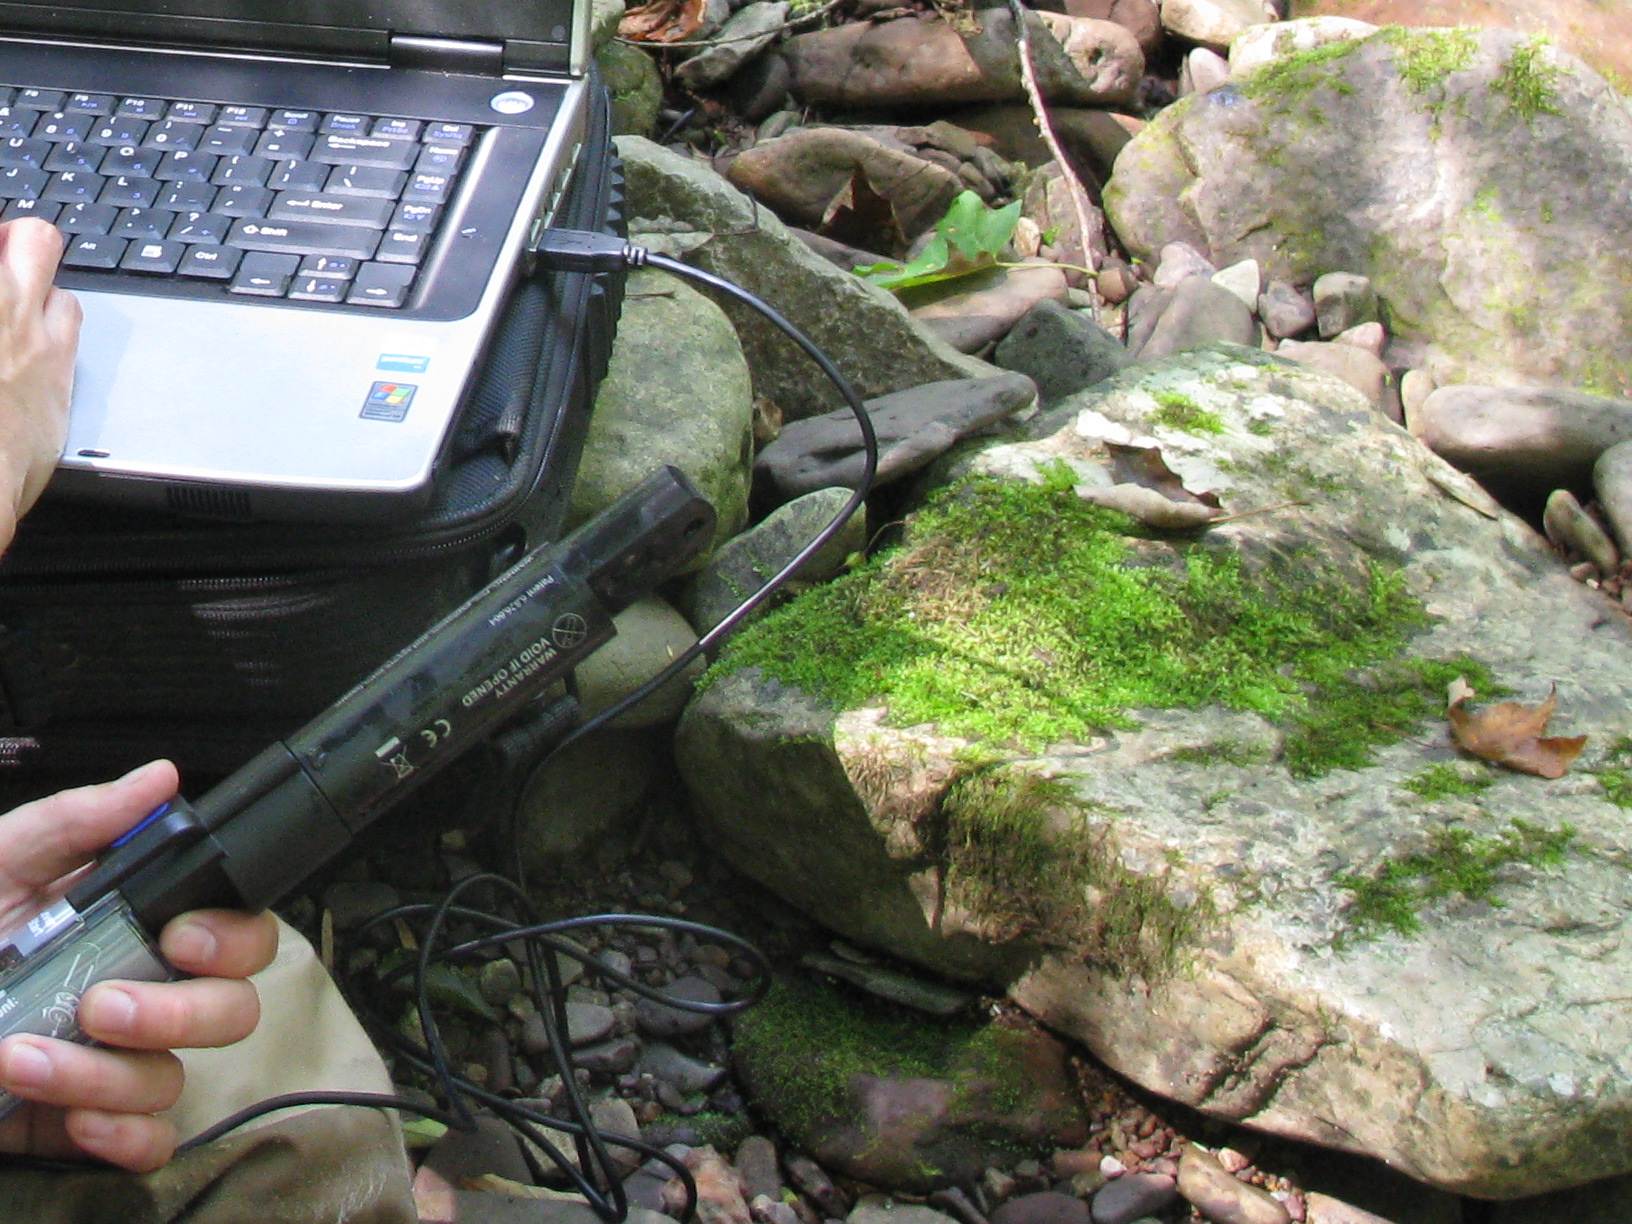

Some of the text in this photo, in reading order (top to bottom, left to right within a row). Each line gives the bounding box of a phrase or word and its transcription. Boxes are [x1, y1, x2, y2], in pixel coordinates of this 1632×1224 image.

[125, 99, 145, 107] F10
[333, 115, 361, 124] Pause
[101, 129, 112, 137] 9
[156, 133, 167, 143] 0
[9, 138, 23, 147] U
[328, 135, 391, 147] Backspace
[120, 147, 135, 156] O
[174, 151, 189, 160] P
[429, 147, 459, 156] Home
[6, 168, 18, 177] J
[62, 172, 75, 182] K
[118, 177, 128, 186] L
[417, 176, 445, 185] PgUp
[18, 199, 35, 209] M
[311, 200, 344, 210] Enter
[404, 205, 432, 215] PgDn
[189, 212, 200, 223] ?
[260, 227, 288, 237] Shift
[393, 233, 418, 243] End
[79, 242, 97, 250] Alt
[195, 251, 218, 261] Ctrl
[526, 575, 555, 598] Patent
[462, 637, 551, 708] VOID IF OPENED
[495, 647, 558, 699] WARRANTY
